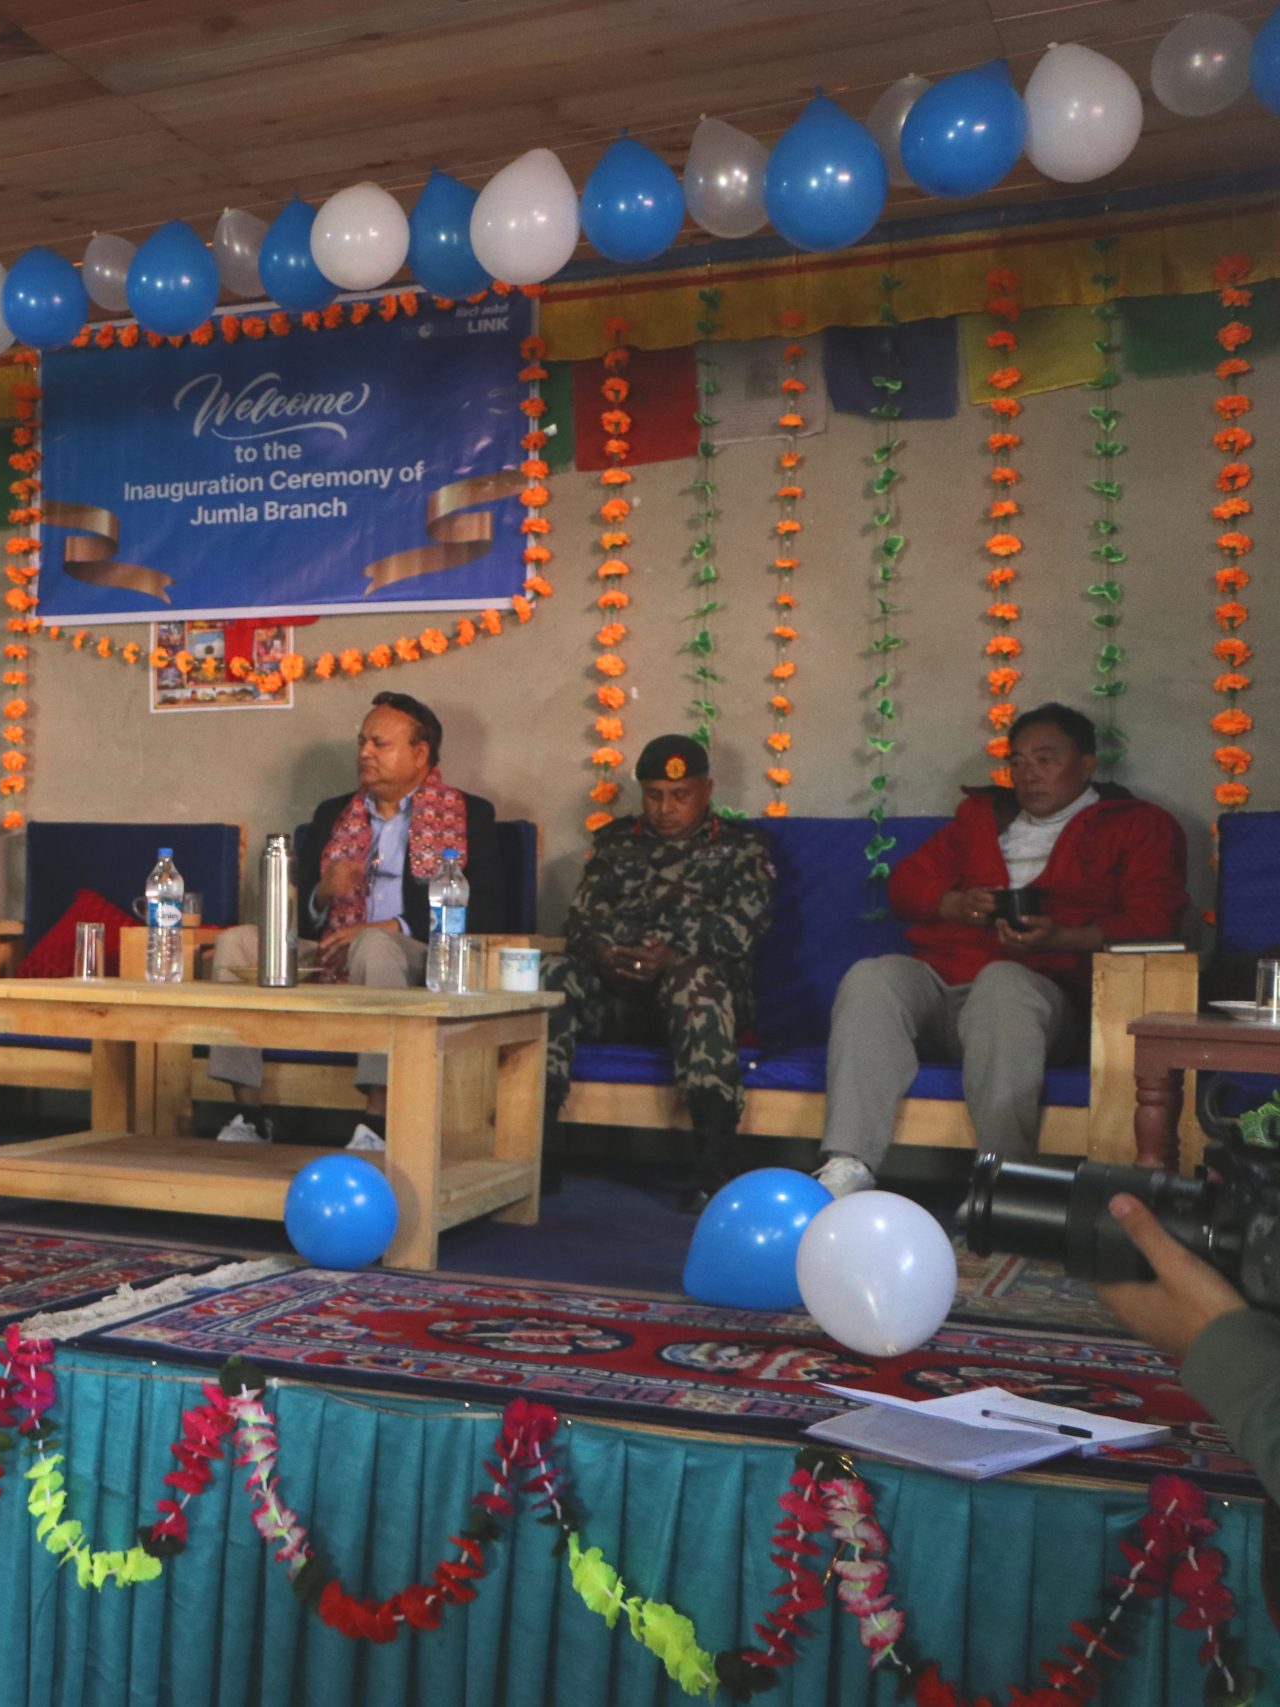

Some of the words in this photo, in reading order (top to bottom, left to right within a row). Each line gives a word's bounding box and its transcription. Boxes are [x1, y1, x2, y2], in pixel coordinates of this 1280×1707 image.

[174, 372, 370, 437] Welcome
[235, 445, 258, 463] to
[263, 441, 302, 461] the
[124, 473, 264, 502] Inauguration
[269, 467, 394, 490] Ceremony
[399, 460, 425, 482] of
[190, 502, 258, 526] Jumla
[263, 497, 348, 521] Branch
